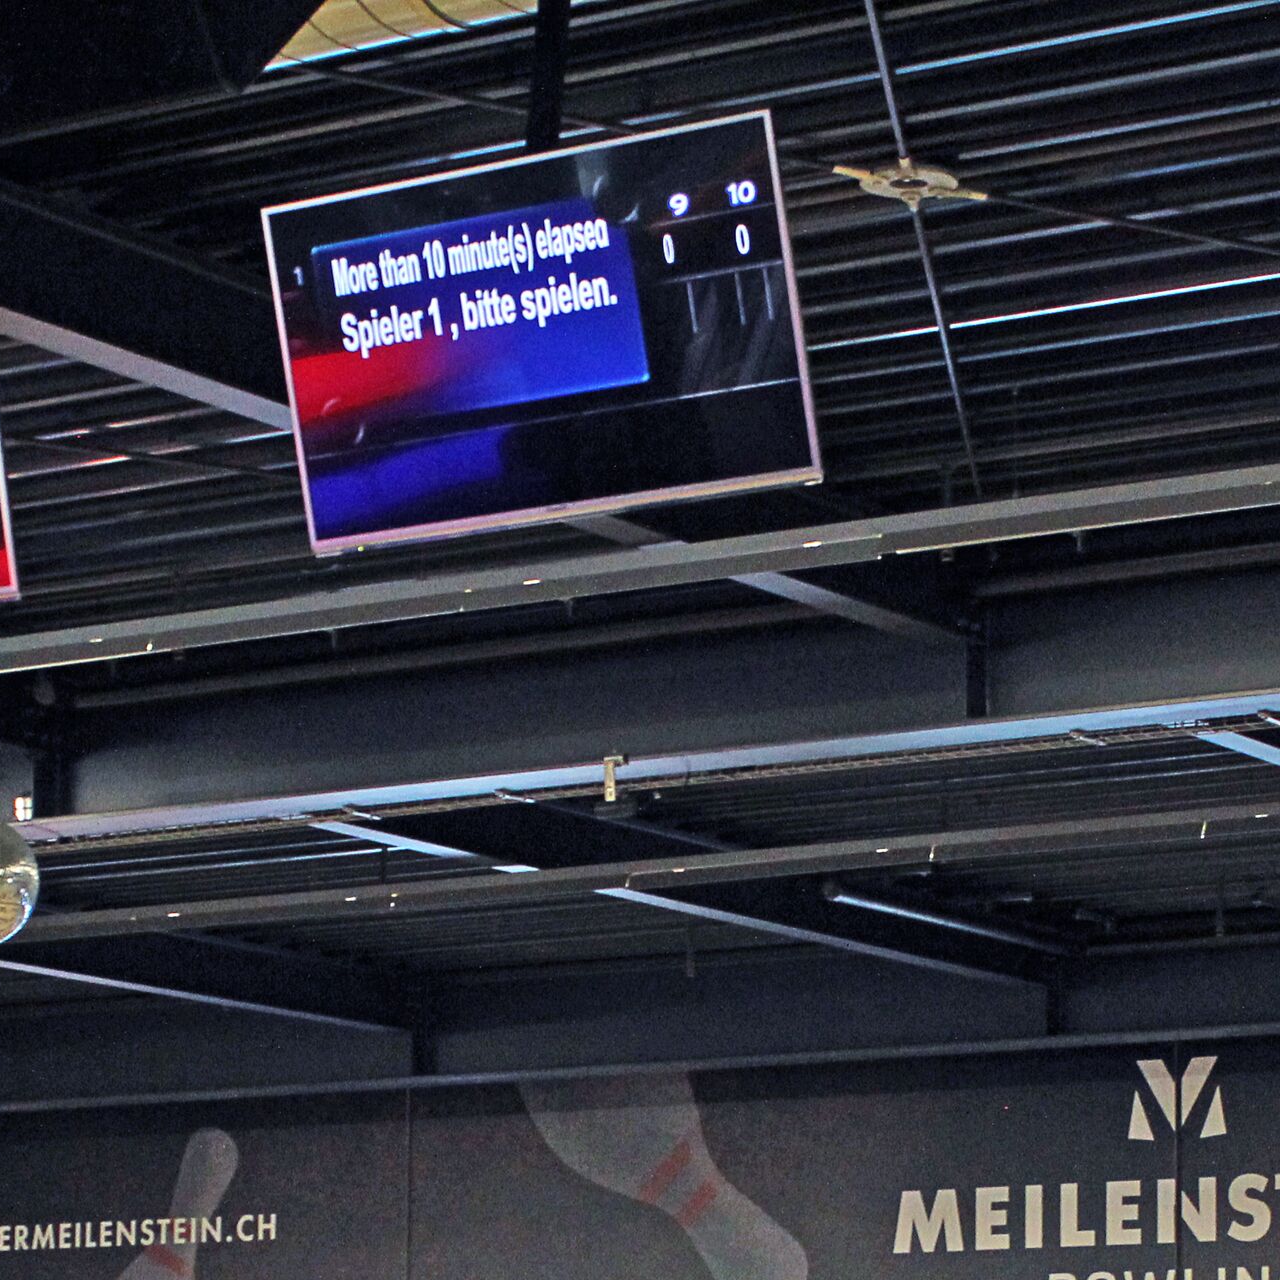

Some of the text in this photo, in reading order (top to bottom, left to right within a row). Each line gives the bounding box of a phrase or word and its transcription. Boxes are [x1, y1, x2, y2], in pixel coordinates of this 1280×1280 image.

[669, 181, 756, 216] 9 10
[331, 218, 610, 297] More than 10 minute(s) elapsed
[663, 224, 750, 264] 0 0
[341, 304, 424, 359] Spieler
[460, 287, 517, 330] bitte
[520, 272, 618, 328] spielen.
